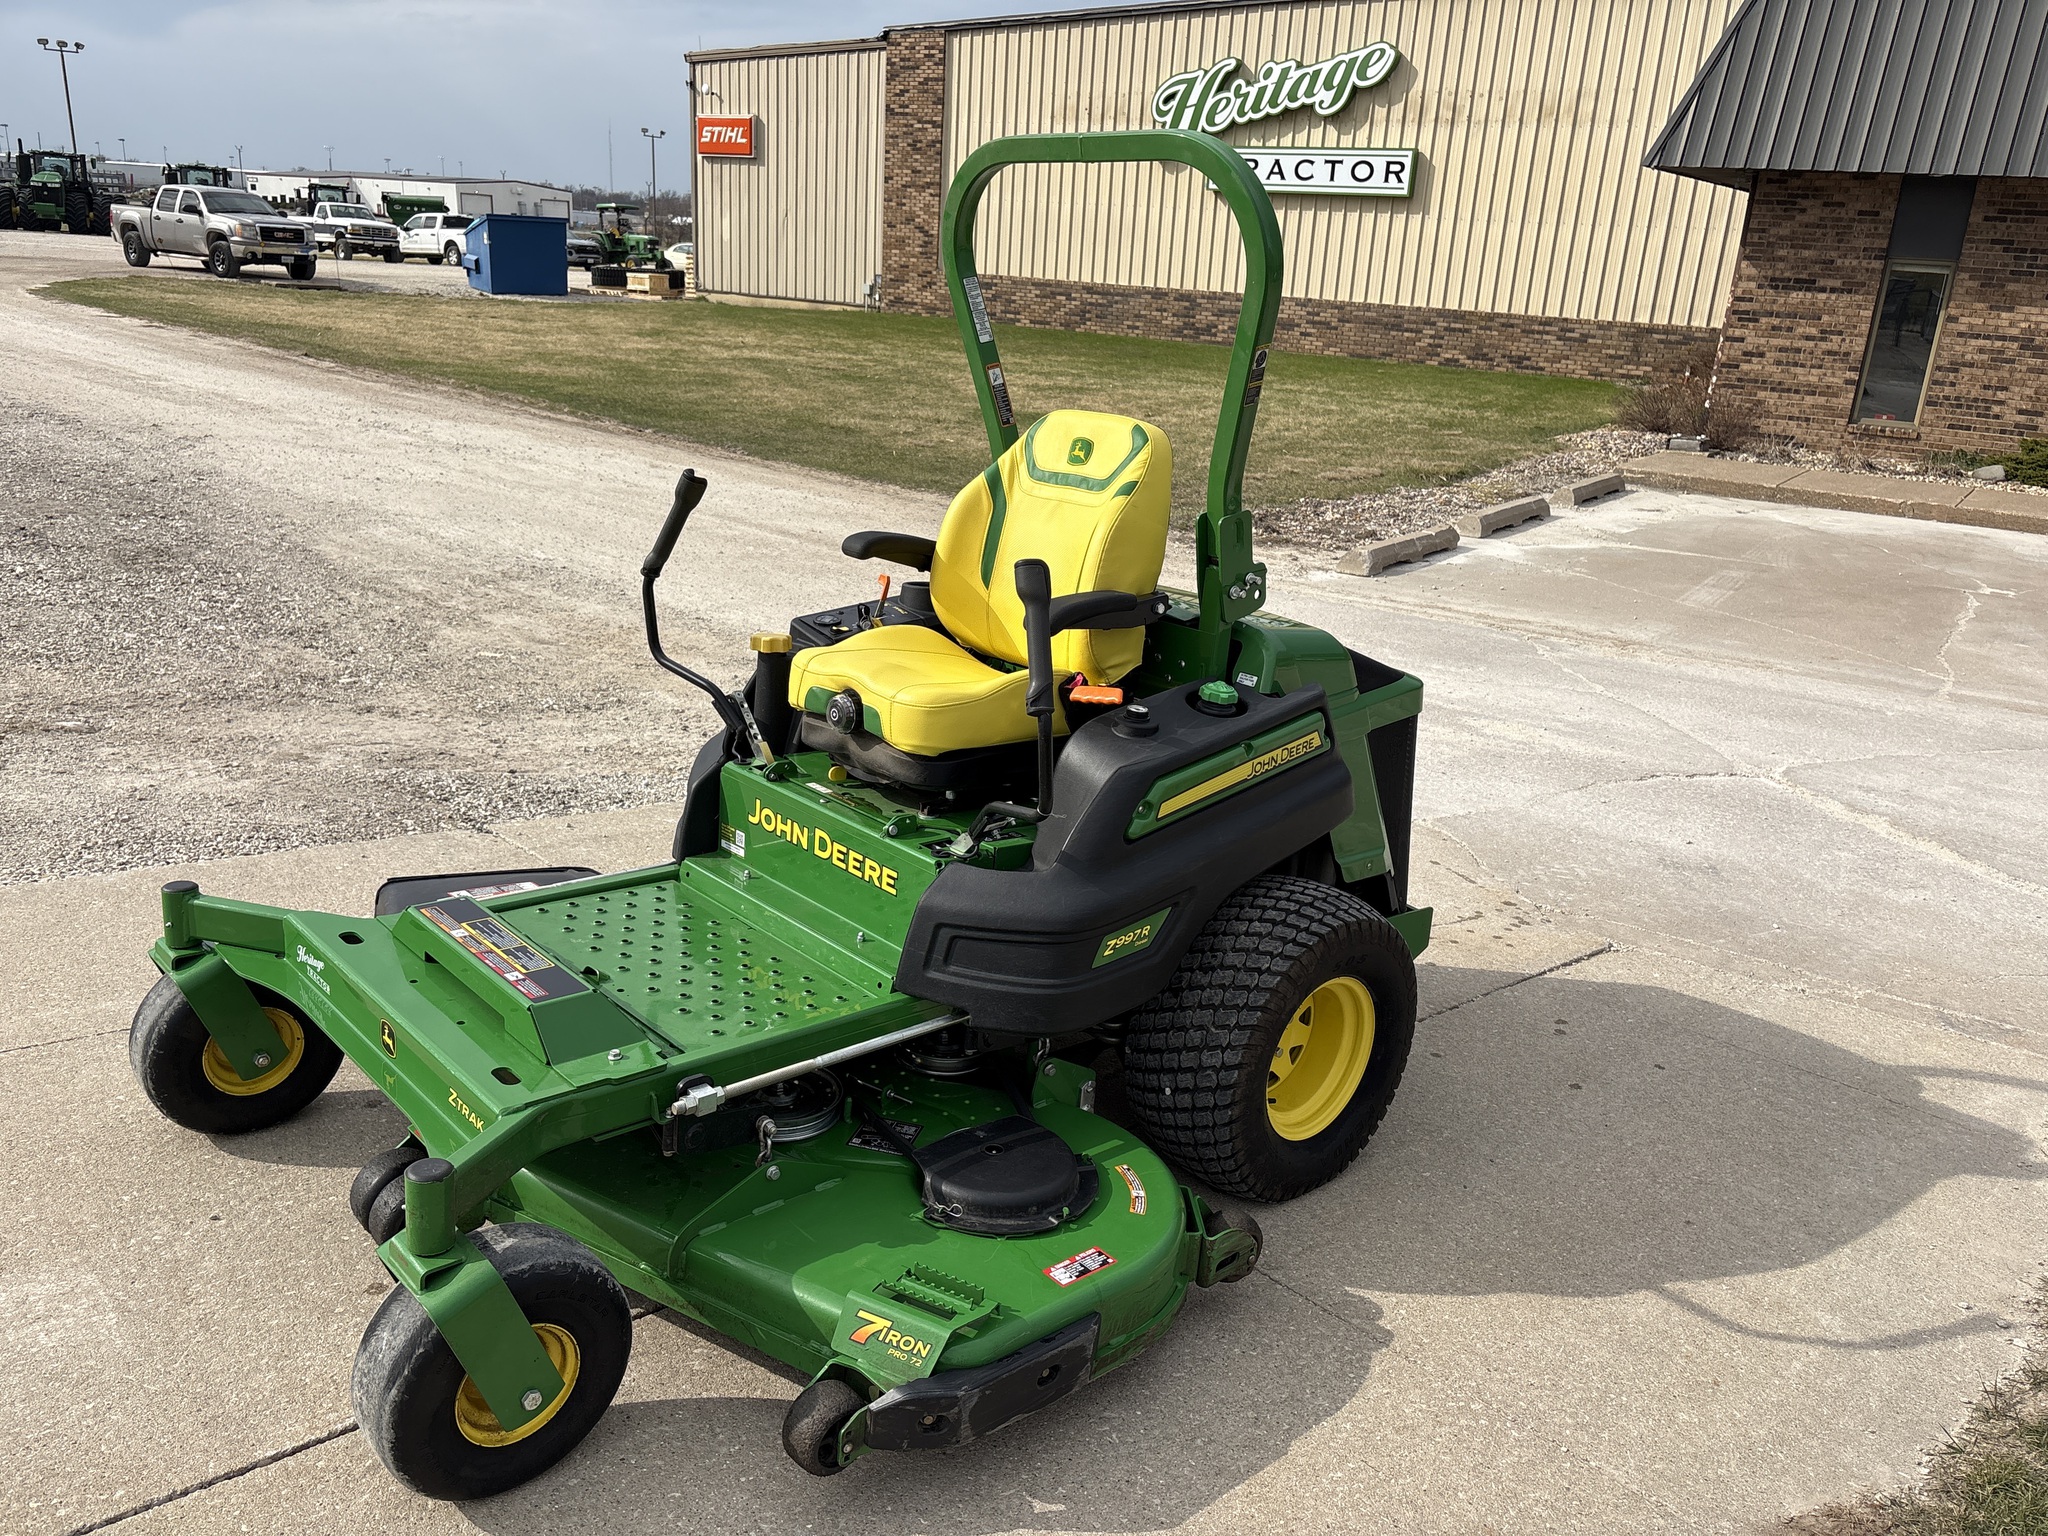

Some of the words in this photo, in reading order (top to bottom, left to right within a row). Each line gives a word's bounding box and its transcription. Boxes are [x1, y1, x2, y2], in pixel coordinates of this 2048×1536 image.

[1155, 46, 1394, 131] Heritage
[700, 126, 748, 143] STIHL
[1244, 158, 1406, 184] ACTOR
[273, 231, 294, 239] GMC
[1247, 753, 1279, 778] JOHN
[1281, 737, 1315, 762] DEERE
[747, 797, 809, 851] JOHN
[813, 826, 899, 897] DEERE
[1103, 925, 1151, 957] Z997R
[448, 1087, 485, 1133] ZTRAK
[887, 1347, 908, 1361] PRO
[909, 1356, 923, 1368] 72
